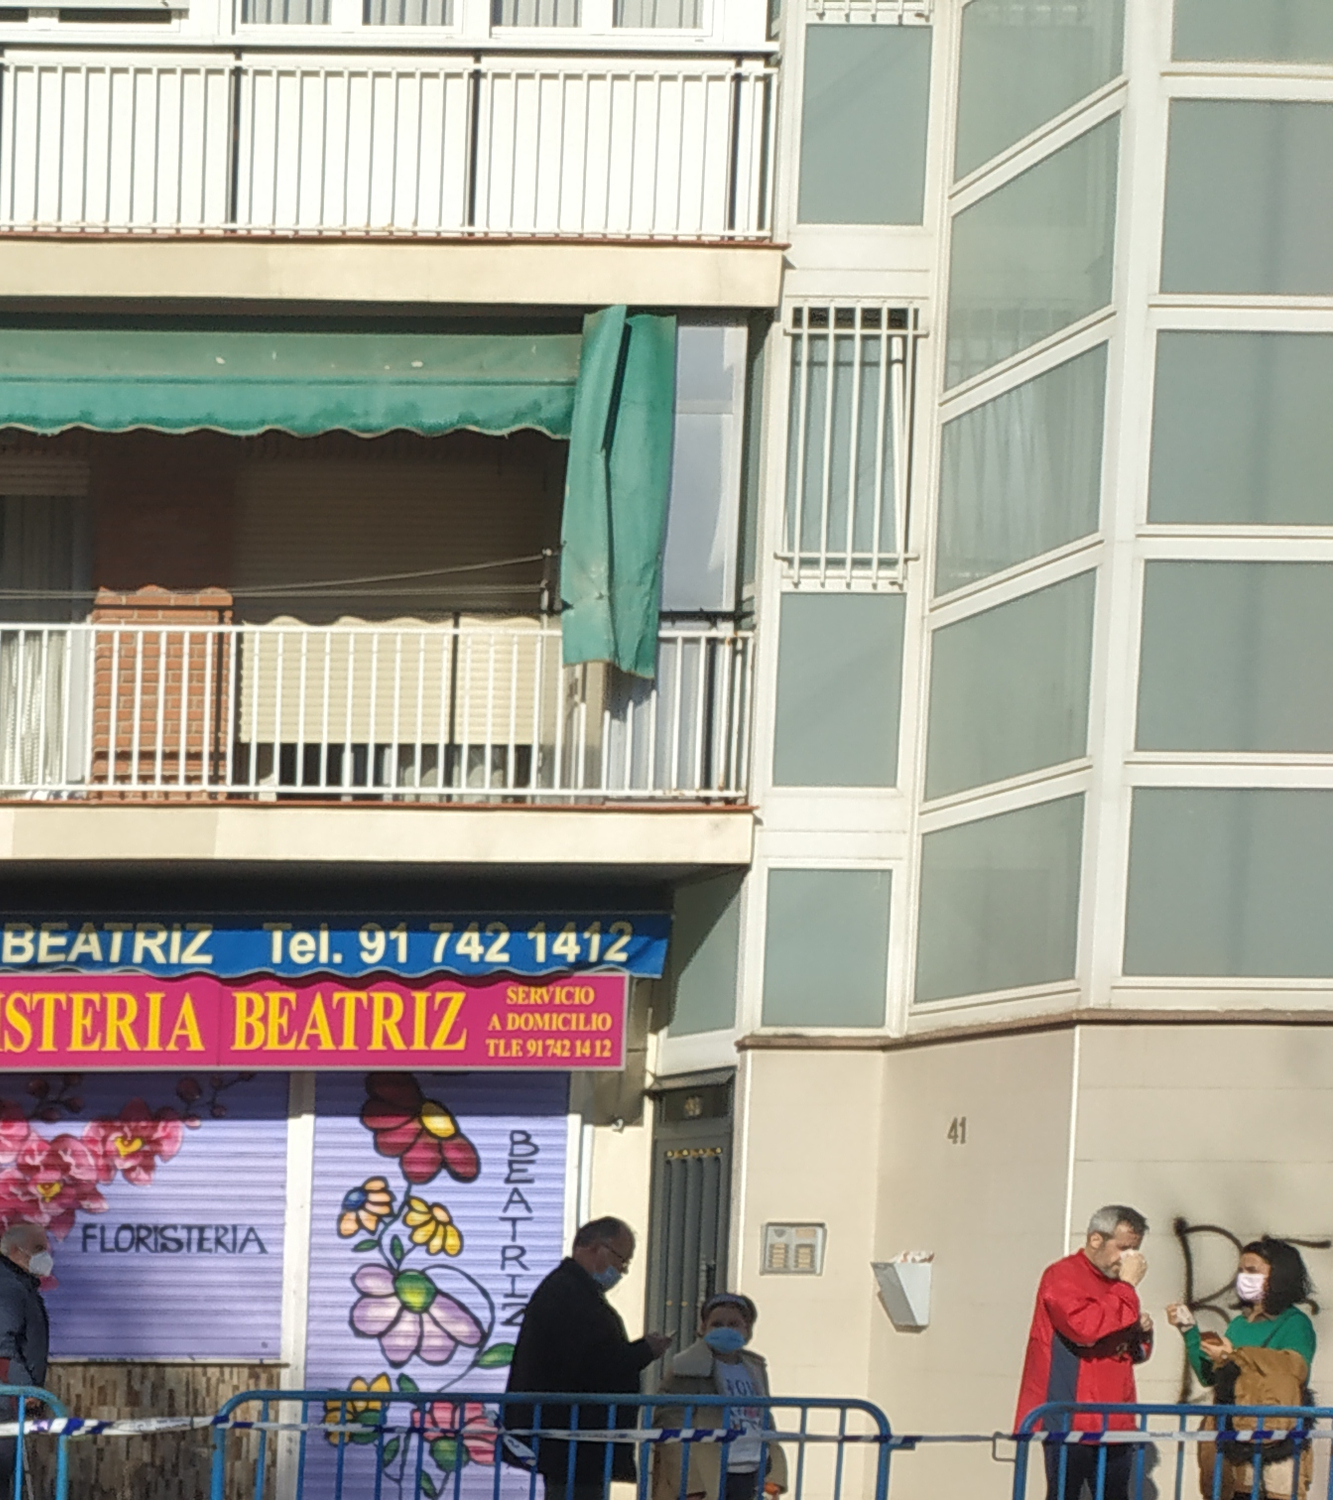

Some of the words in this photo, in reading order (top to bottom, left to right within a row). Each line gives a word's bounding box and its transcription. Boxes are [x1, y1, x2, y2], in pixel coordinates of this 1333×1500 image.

[1, 922, 214, 965] BEATRIZ
[264, 922, 342, 965] Tel.
[359, 922, 408, 964] 91
[429, 922, 511, 964] 742
[527, 921, 633, 964] 1412
[505, 986, 596, 1006] SERVICIO
[229, 990, 468, 1052] BEATRIZ
[488, 1013, 502, 1031] A
[505, 1013, 612, 1032] DOMICILIO
[947, 1116, 968, 1145] 41
[82, 1223, 268, 1255] FLORISTERIA
[499, 1130, 539, 1327] BEATRIZ
